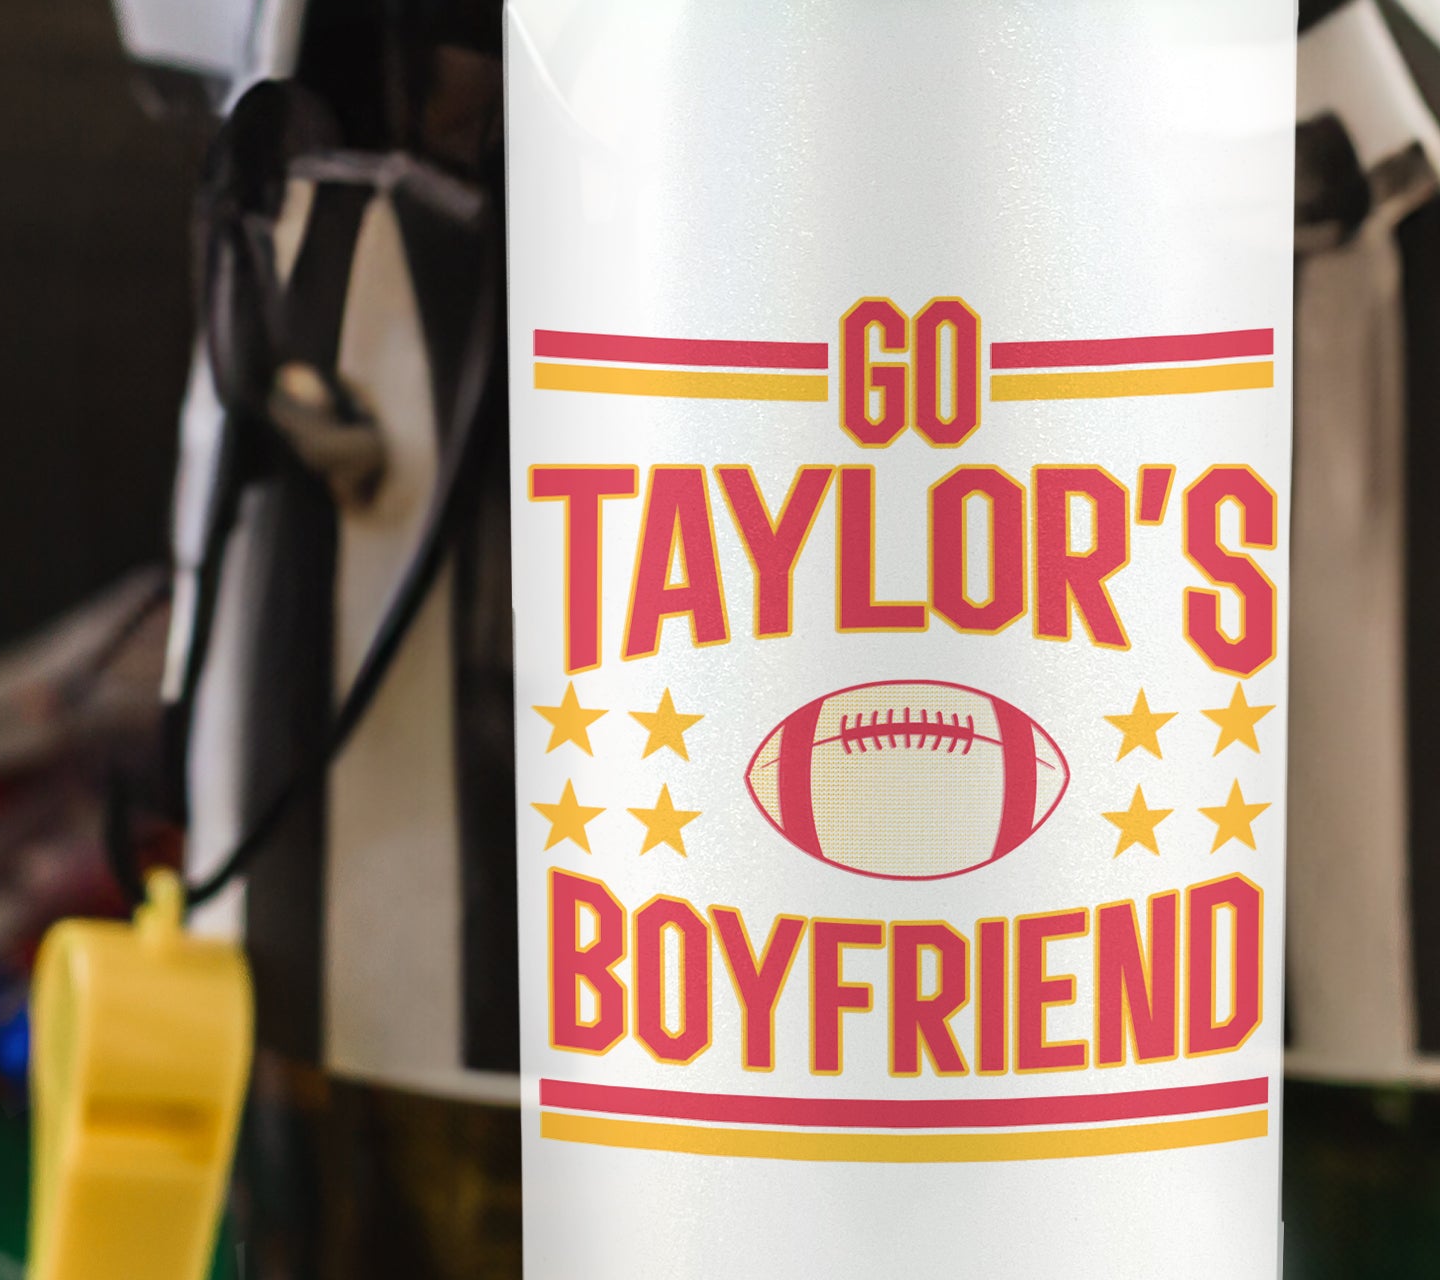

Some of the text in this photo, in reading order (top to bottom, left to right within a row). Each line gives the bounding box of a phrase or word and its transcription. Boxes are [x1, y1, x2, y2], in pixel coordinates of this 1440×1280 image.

[839, 296, 981, 449] GO
[528, 464, 1278, 679] TAYLOR'S
[547, 866, 1264, 1078] BOYFRIEND
